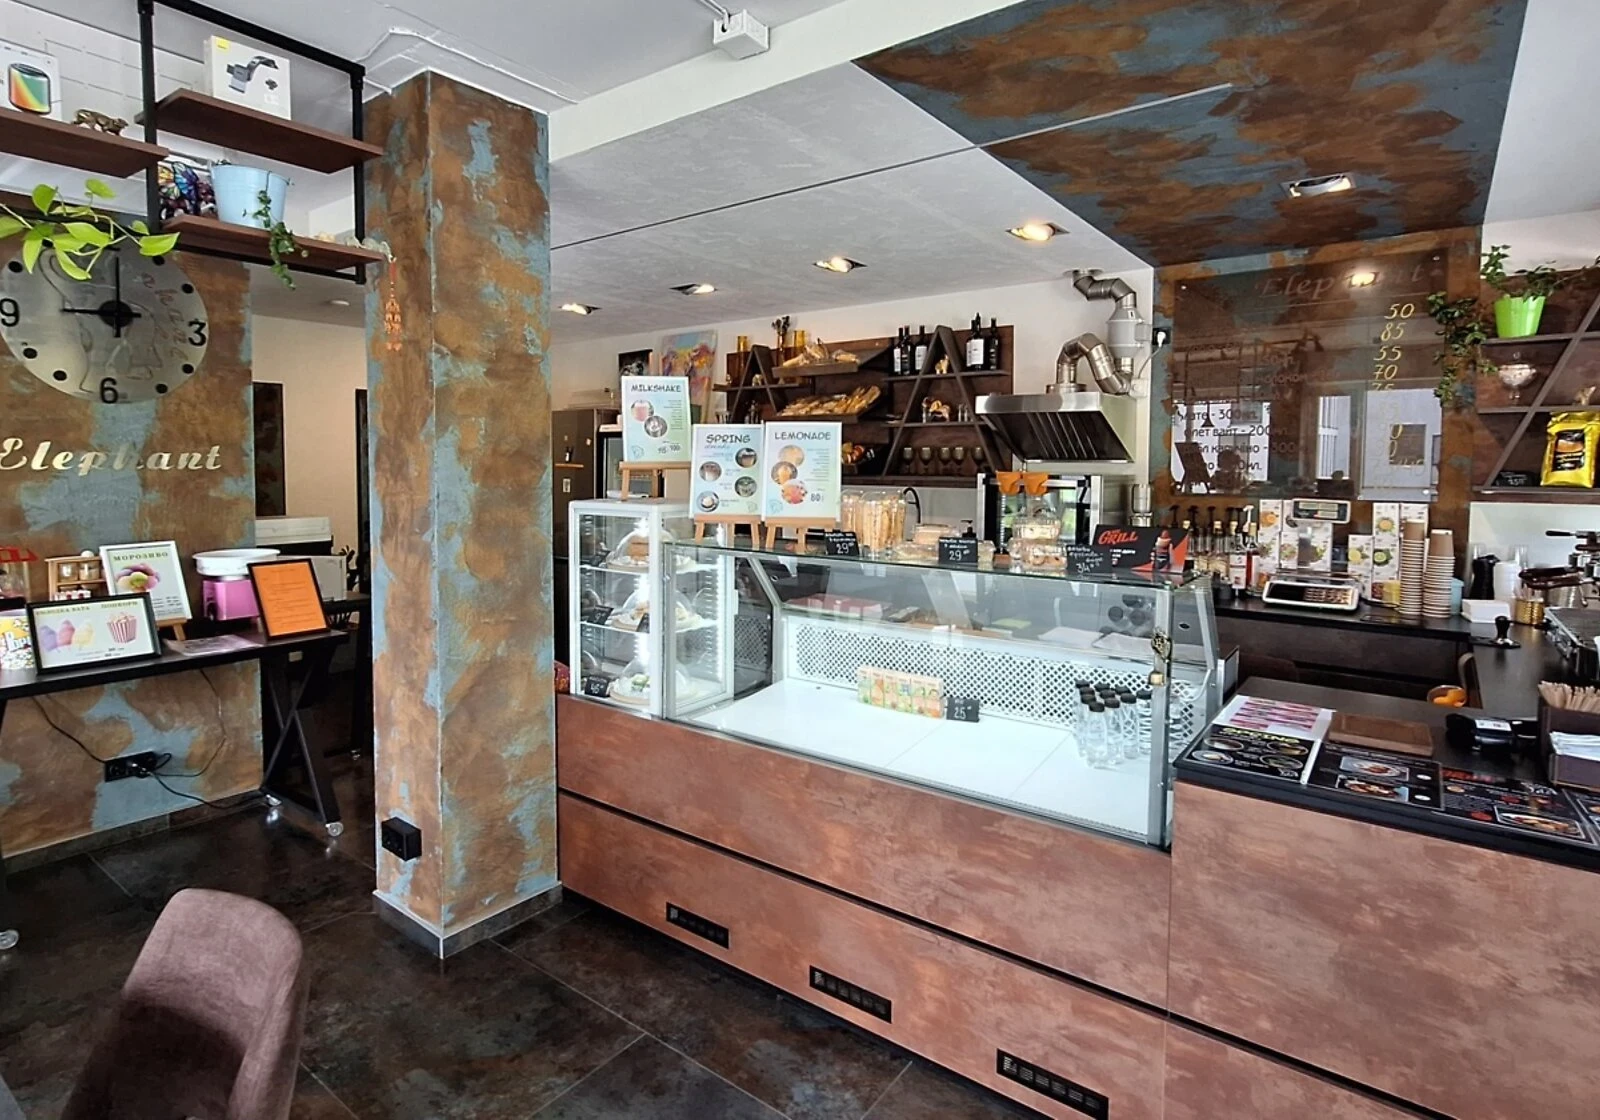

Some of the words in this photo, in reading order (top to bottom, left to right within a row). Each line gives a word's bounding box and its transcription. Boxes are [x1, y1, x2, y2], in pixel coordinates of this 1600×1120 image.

[0, 298, 20, 327] 9
[1384, 303, 1415, 320] 50
[187, 320, 207, 346] 3
[1380, 322, 1407, 342] 85
[1373, 346, 1402, 361] 55
[1373, 364, 1398, 380] 70
[100, 377, 119, 404] 6
[630, 384, 682, 393] MILKSHAKE
[705, 433, 751, 444] SPRING
[774, 431, 831, 440] LEMONADE
[0, 437, 222, 476] Elephant
[1098, 529, 1139, 545] GRILL
